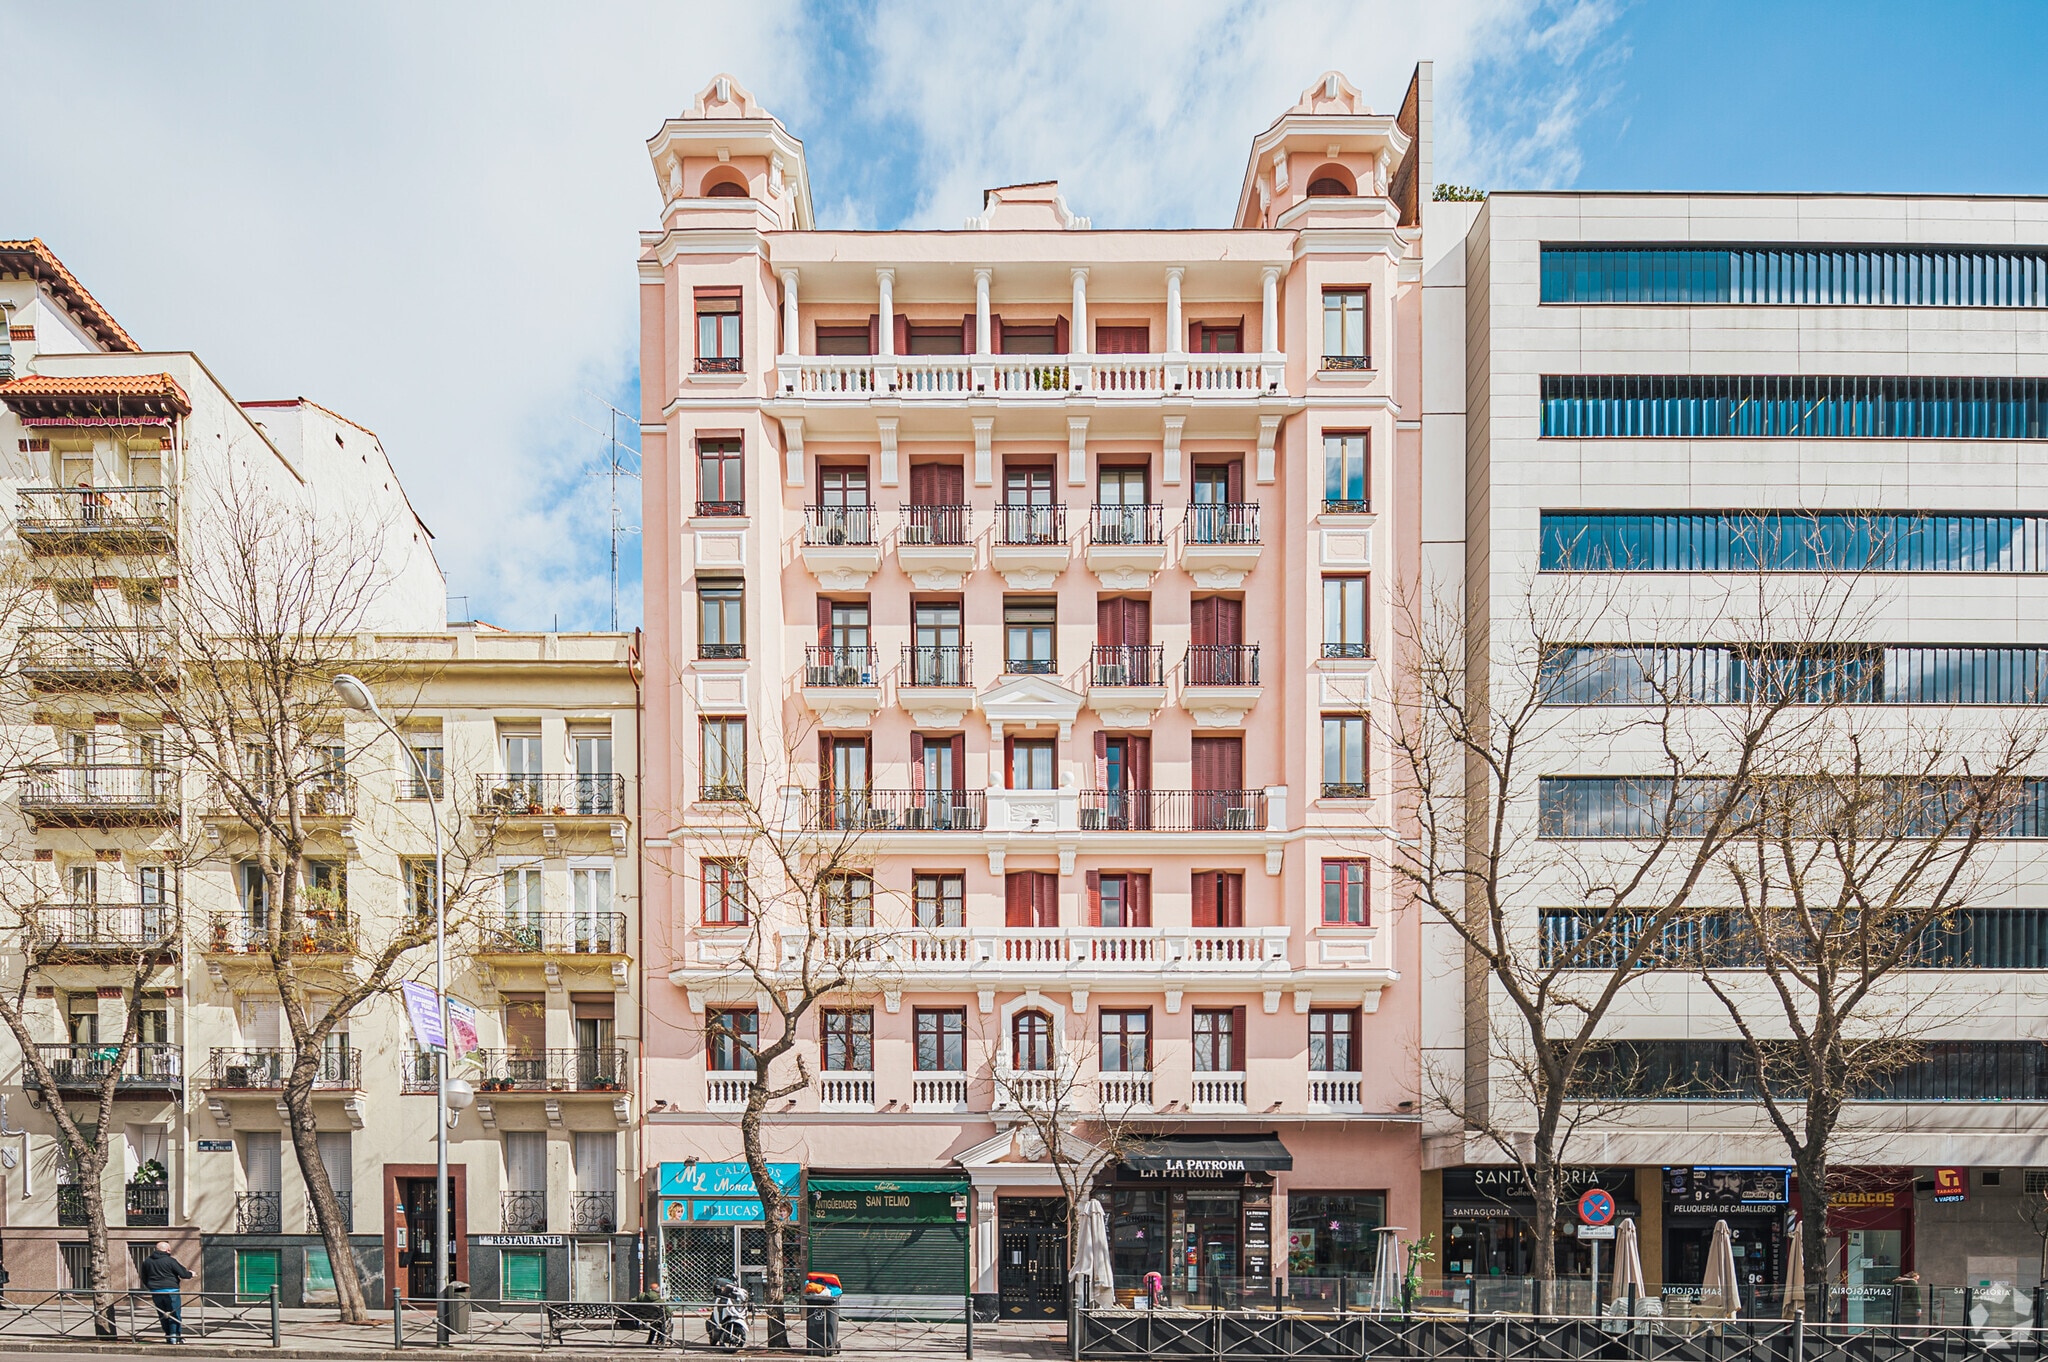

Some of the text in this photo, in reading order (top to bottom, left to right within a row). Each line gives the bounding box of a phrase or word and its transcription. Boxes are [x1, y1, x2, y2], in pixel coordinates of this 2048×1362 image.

[1166, 1159, 1245, 1170] LA PATRONA
[715, 1164, 782, 1177] CALZOS
[1475, 1170, 1599, 1184] SANTORIA
[815, 1198, 857, 1210] ANTIGÜEDADES
[865, 1195, 910, 1207] SAN TELMO
[703, 1205, 759, 1216] PELUCAS
[1453, 1208, 1509, 1216] SANTAGLORIA
[1674, 1203, 1776, 1213] PELUQUERÍA DE CABALLEROS
[816, 1210, 826, 1218] 52
[493, 1236, 561, 1245] RESTAURANTE
[1954, 1288, 2011, 1296] SAAGLORIA
